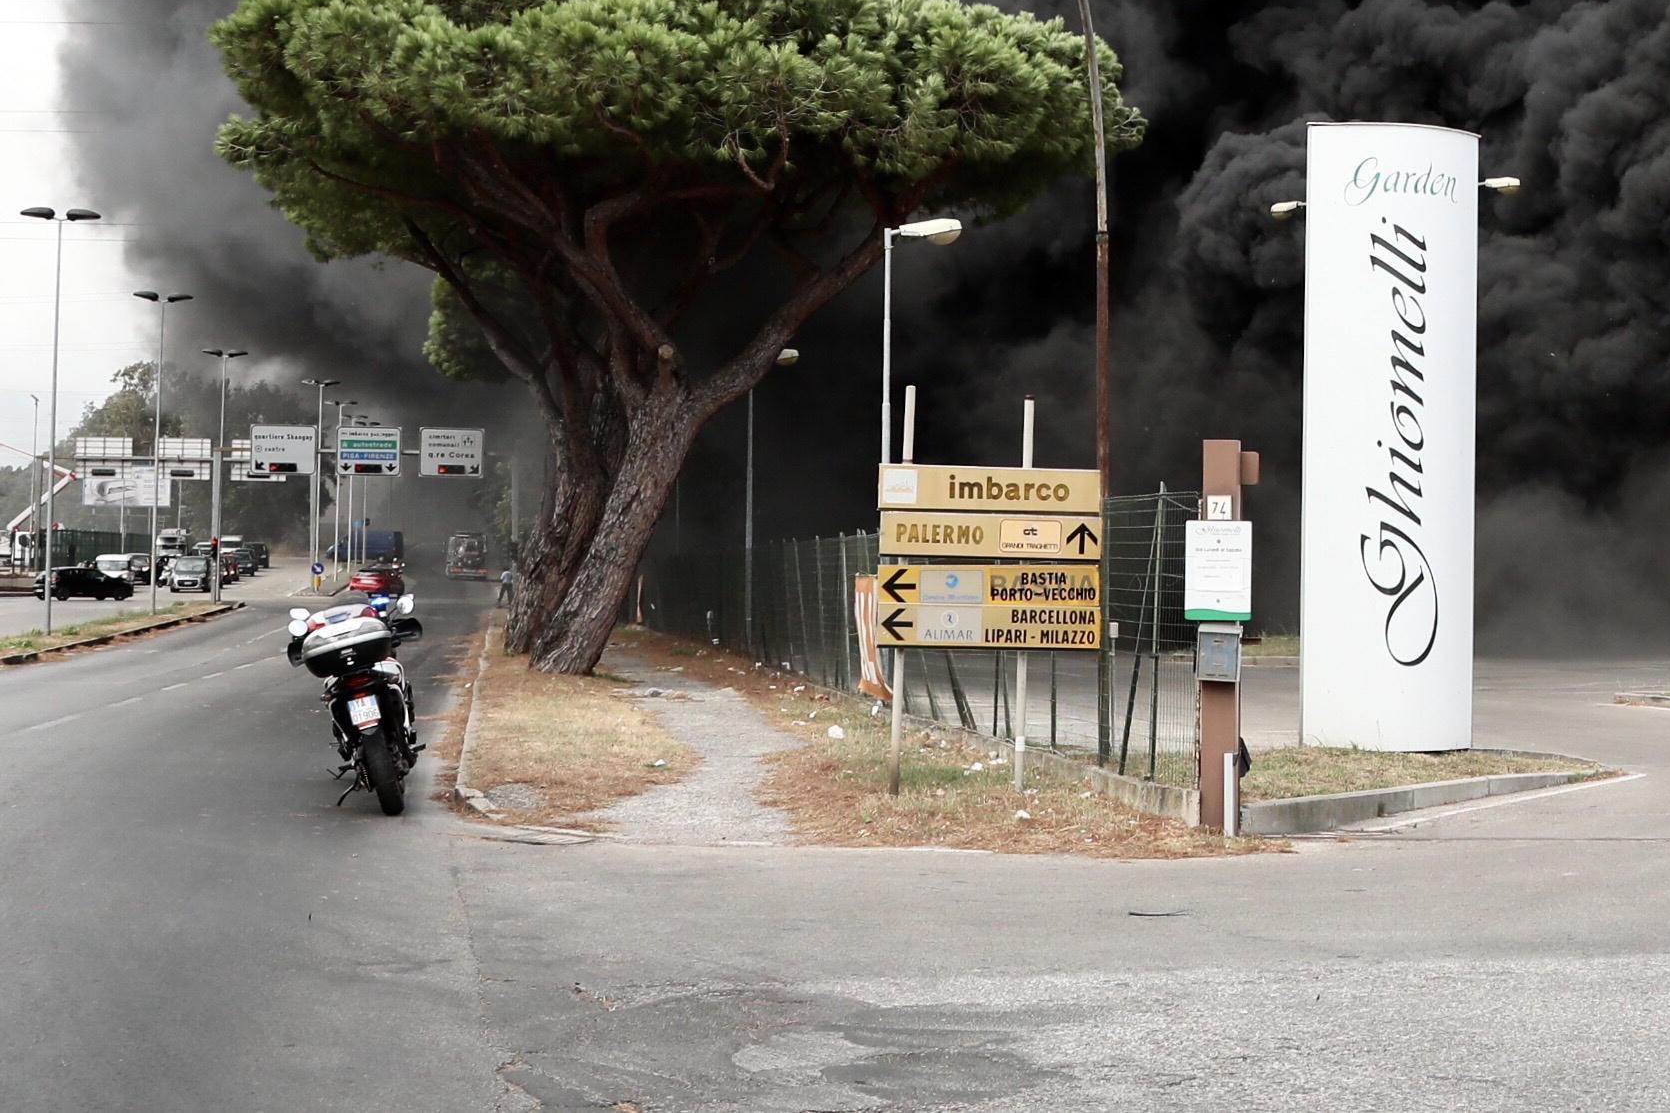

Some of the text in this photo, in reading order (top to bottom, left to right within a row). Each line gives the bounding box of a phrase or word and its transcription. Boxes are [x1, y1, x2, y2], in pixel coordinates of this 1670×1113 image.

[1344, 156, 1457, 206] Garden
[1360, 216, 1439, 667] Ghiomelli
[949, 474, 1070, 502] imbarco
[895, 523, 984, 545] PALERMO
[1001, 542, 1059, 551] GRANDI TRAGHETTI
[1020, 572, 1067, 585] BASTIA
[1011, 609, 1096, 625] BARCELLONA
[923, 629, 974, 641] ALIMAR
[984, 628, 1027, 644] LIPARI
[1040, 630, 1096, 645] MILAZZO
